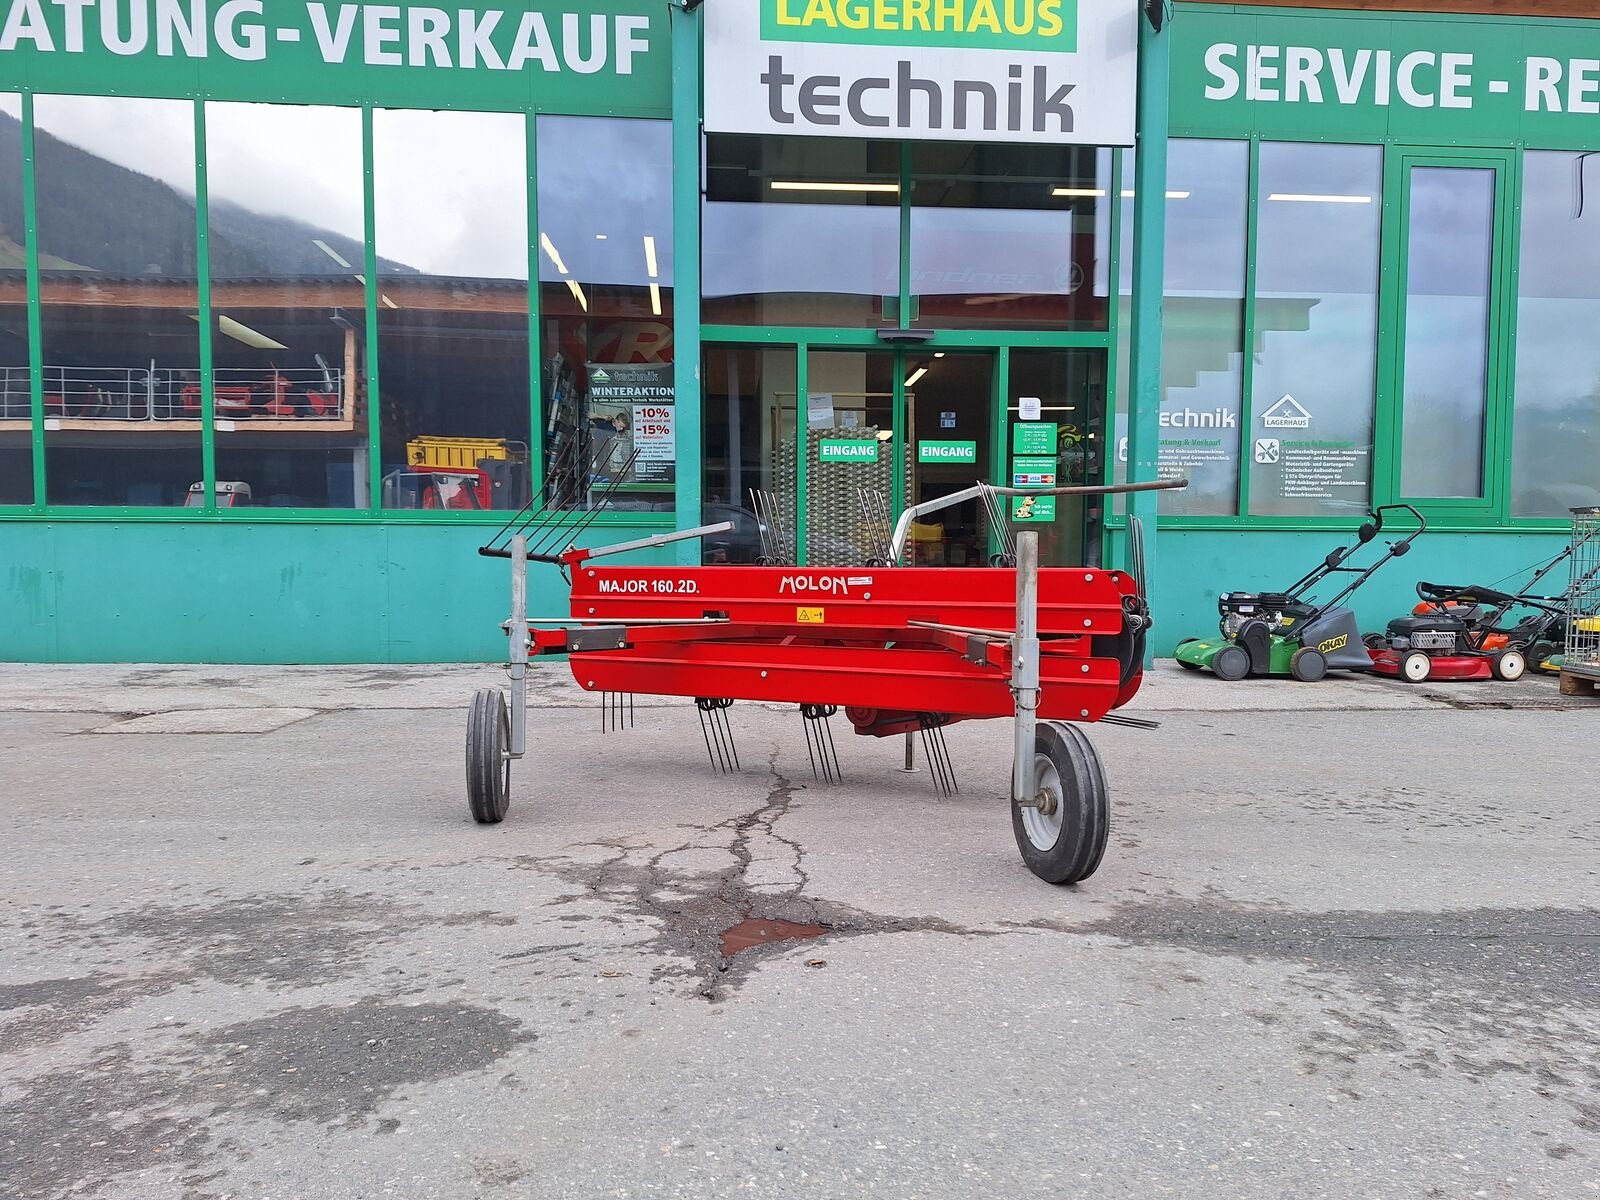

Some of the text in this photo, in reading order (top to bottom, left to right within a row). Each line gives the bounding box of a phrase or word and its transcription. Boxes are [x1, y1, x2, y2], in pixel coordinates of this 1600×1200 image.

[775, 0, 1064, 37] LAGERHAUS
[1204, 43, 1474, 109] SERVICE
[760, 55, 1077, 133] technik
[591, 387, 674, 396] WINTERAKTION
[635, 408, 669, 418] -10%
[635, 425, 670, 434] -15%
[1266, 419, 1307, 427] LAGERHAUS
[823, 444, 875, 457] EINGANG
[921, 446, 973, 458] EINGANG
[599, 580, 648, 593] MAJOR
[778, 575, 849, 595] MOLON
[1319, 635, 1347, 653] OKAY
